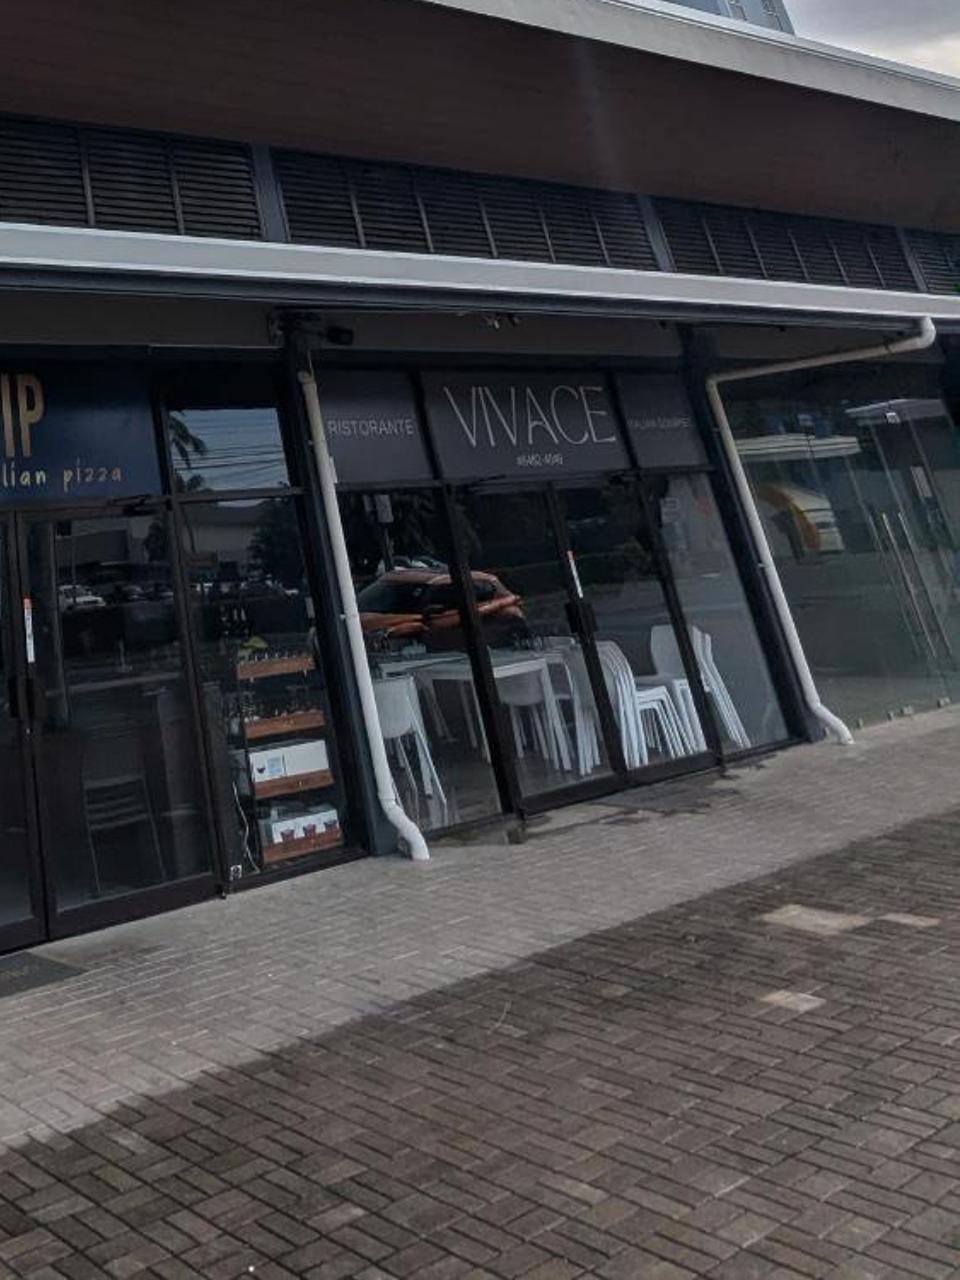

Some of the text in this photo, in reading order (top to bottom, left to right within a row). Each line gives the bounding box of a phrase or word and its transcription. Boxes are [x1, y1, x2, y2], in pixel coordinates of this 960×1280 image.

[327, 418, 414, 438] RISTORANTE
[443, 385, 617, 448] VIVACE
[63, 458, 123, 493] pizza
